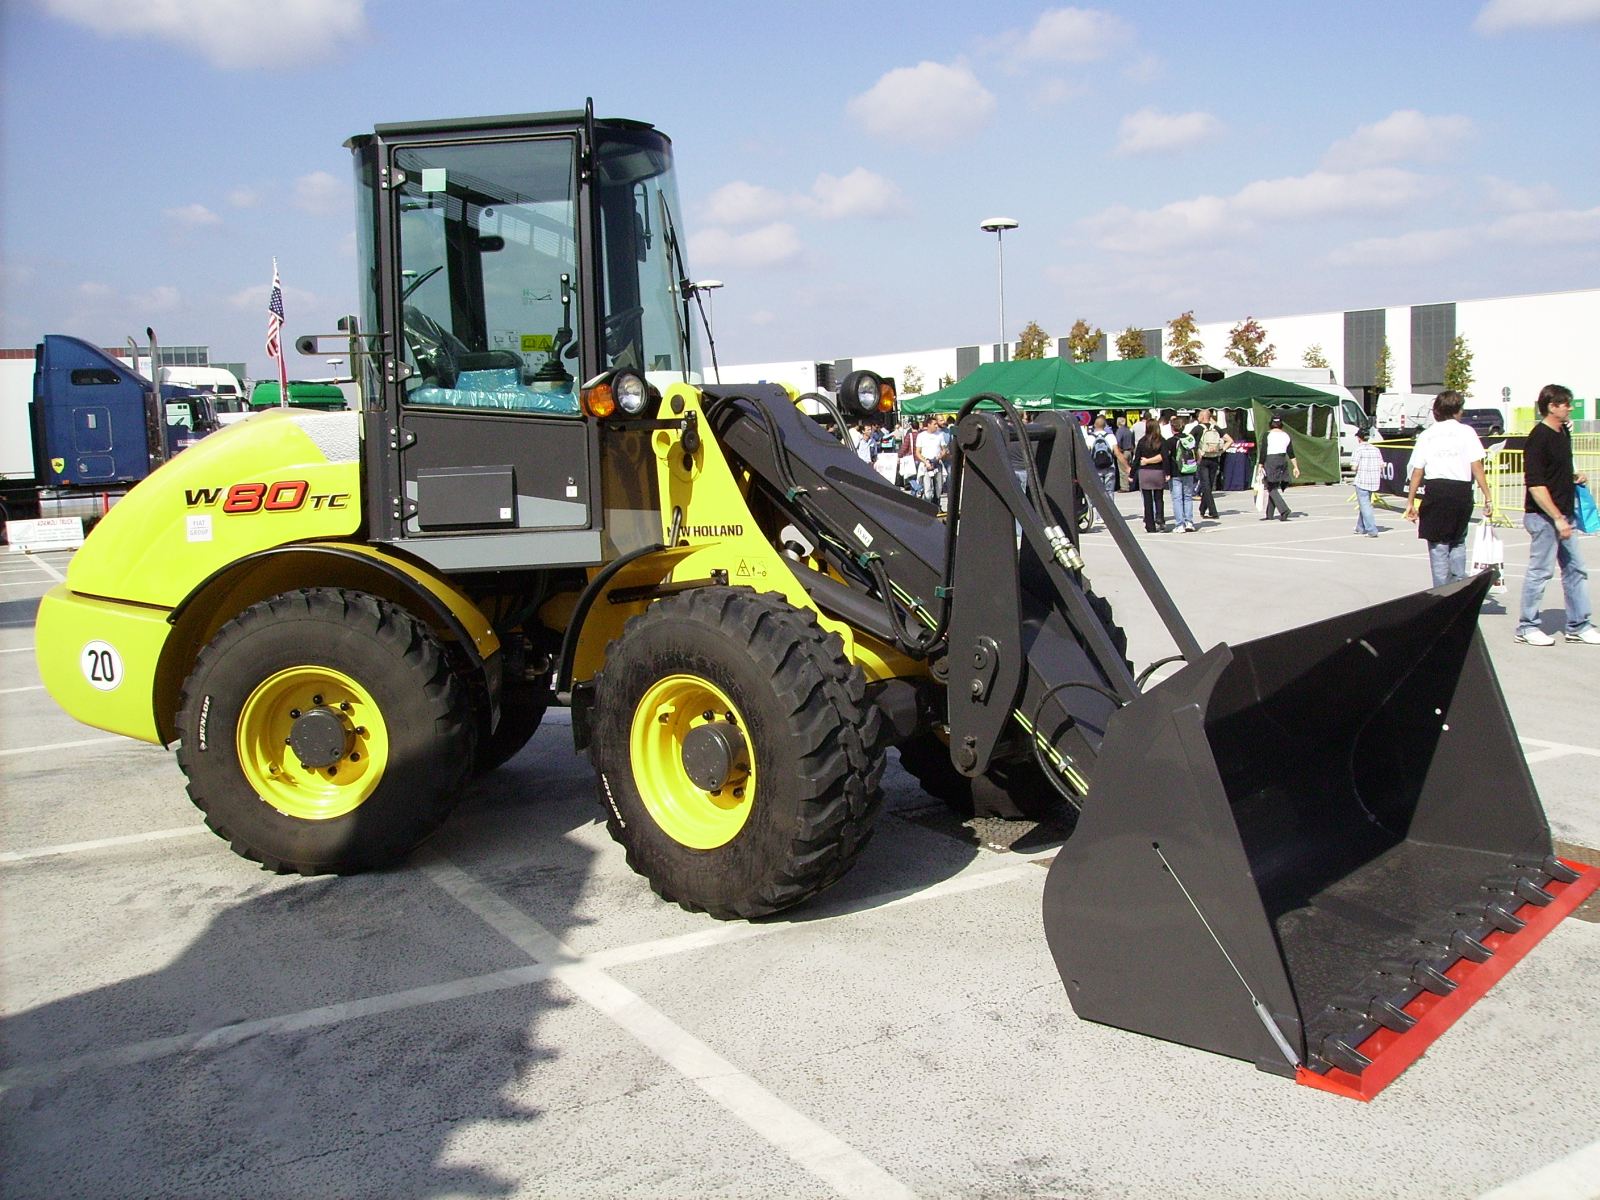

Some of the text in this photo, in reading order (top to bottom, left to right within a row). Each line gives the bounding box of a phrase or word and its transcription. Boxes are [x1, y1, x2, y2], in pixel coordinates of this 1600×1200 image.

[667, 524, 743, 537] NW HOLLAND
[88, 649, 114, 682] 20
[199, 695, 210, 742] DUNLOP
[601, 773, 622, 820] DUNLOP
